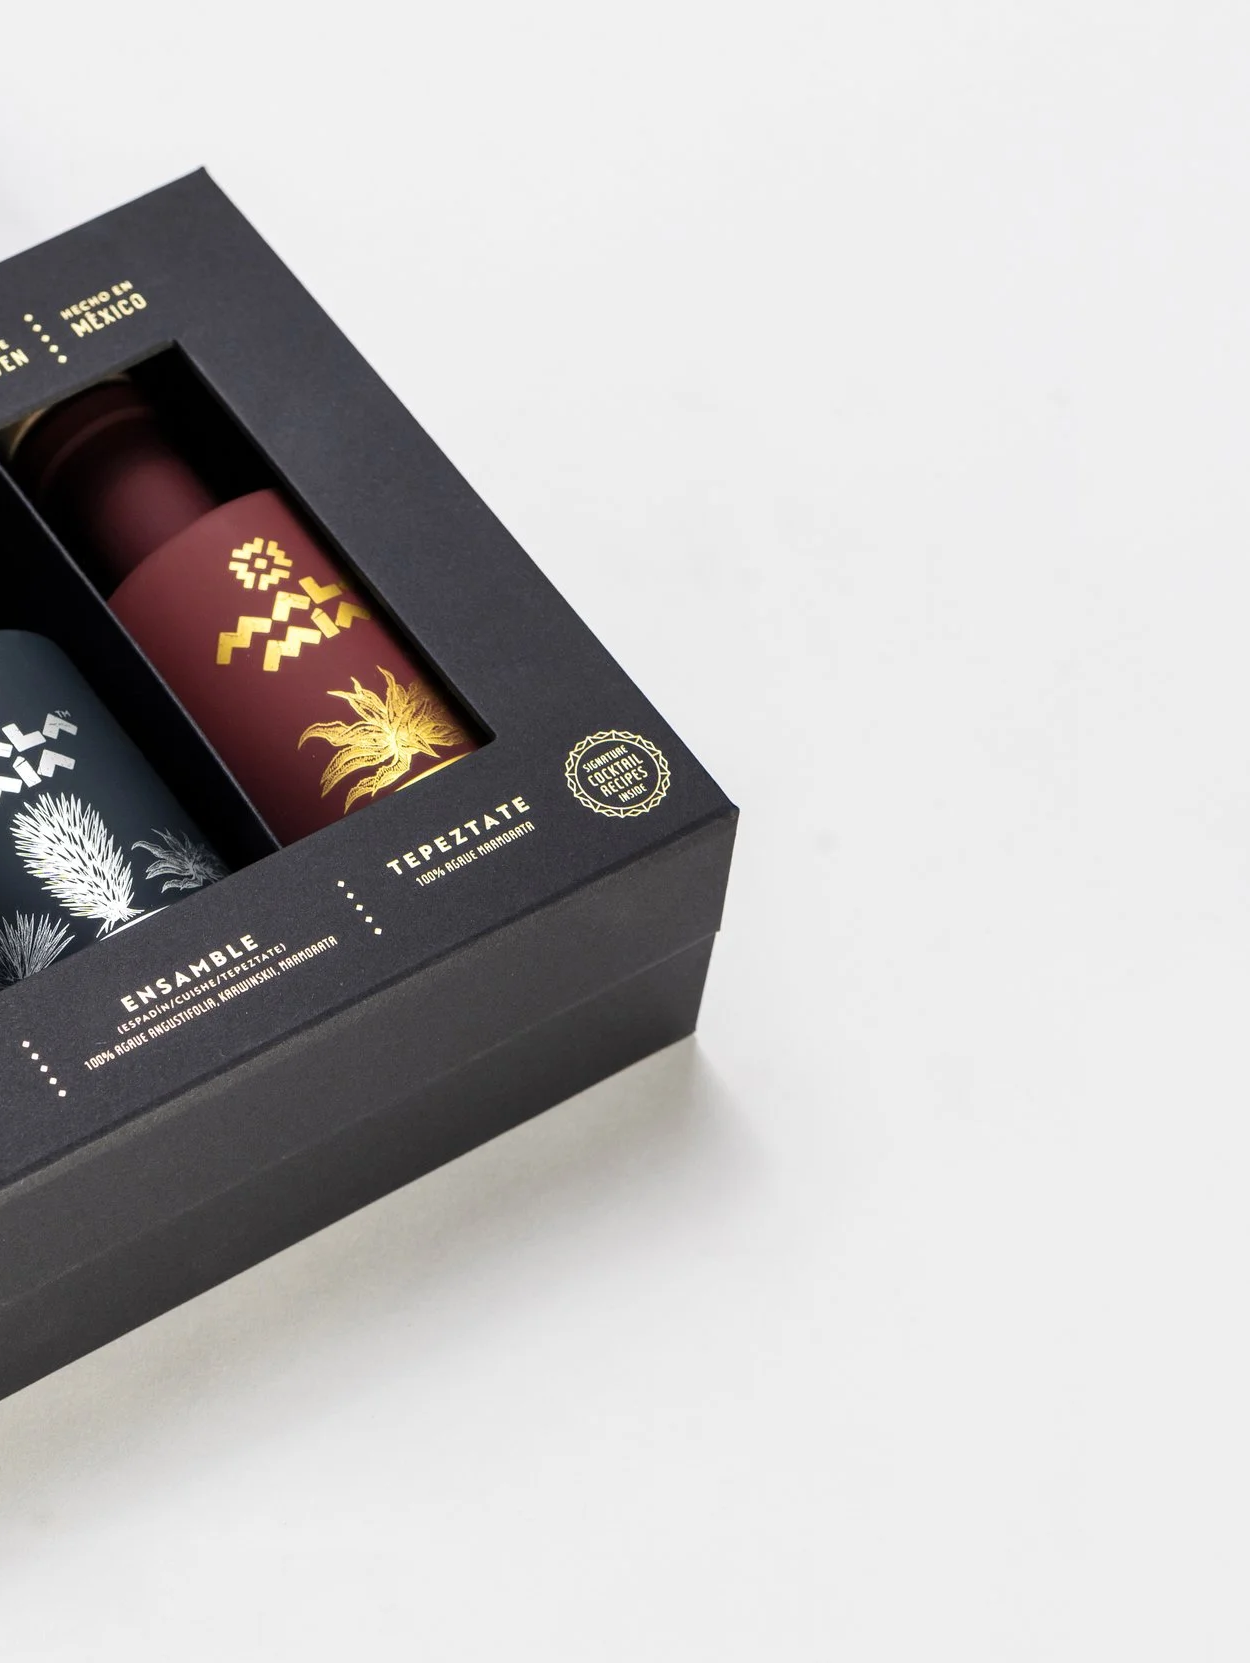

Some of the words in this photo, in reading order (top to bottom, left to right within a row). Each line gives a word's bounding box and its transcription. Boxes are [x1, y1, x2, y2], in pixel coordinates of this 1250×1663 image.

[60, 291, 110, 320] HECHO
[111, 281, 133, 297] EN
[71, 293, 147, 337] MÉXICO
[583, 745, 628, 772] SIGNATURE
[588, 754, 643, 786] COCKTAIL
[600, 766, 648, 797] RECIPES
[618, 783, 647, 802] INSIDE
[387, 797, 530, 875] TEPEZTATE
[416, 867, 445, 886] 100%
[477, 821, 535, 856] MARMORATA
[121, 935, 258, 1012] ENSAMBLE
[84, 1050, 115, 1070] 100%
[148, 998, 220, 1038] ANGUSTIFOLIA,
[218, 967, 277, 1002] KARWINSKII,
[278, 936, 337, 971] MARMORATA
